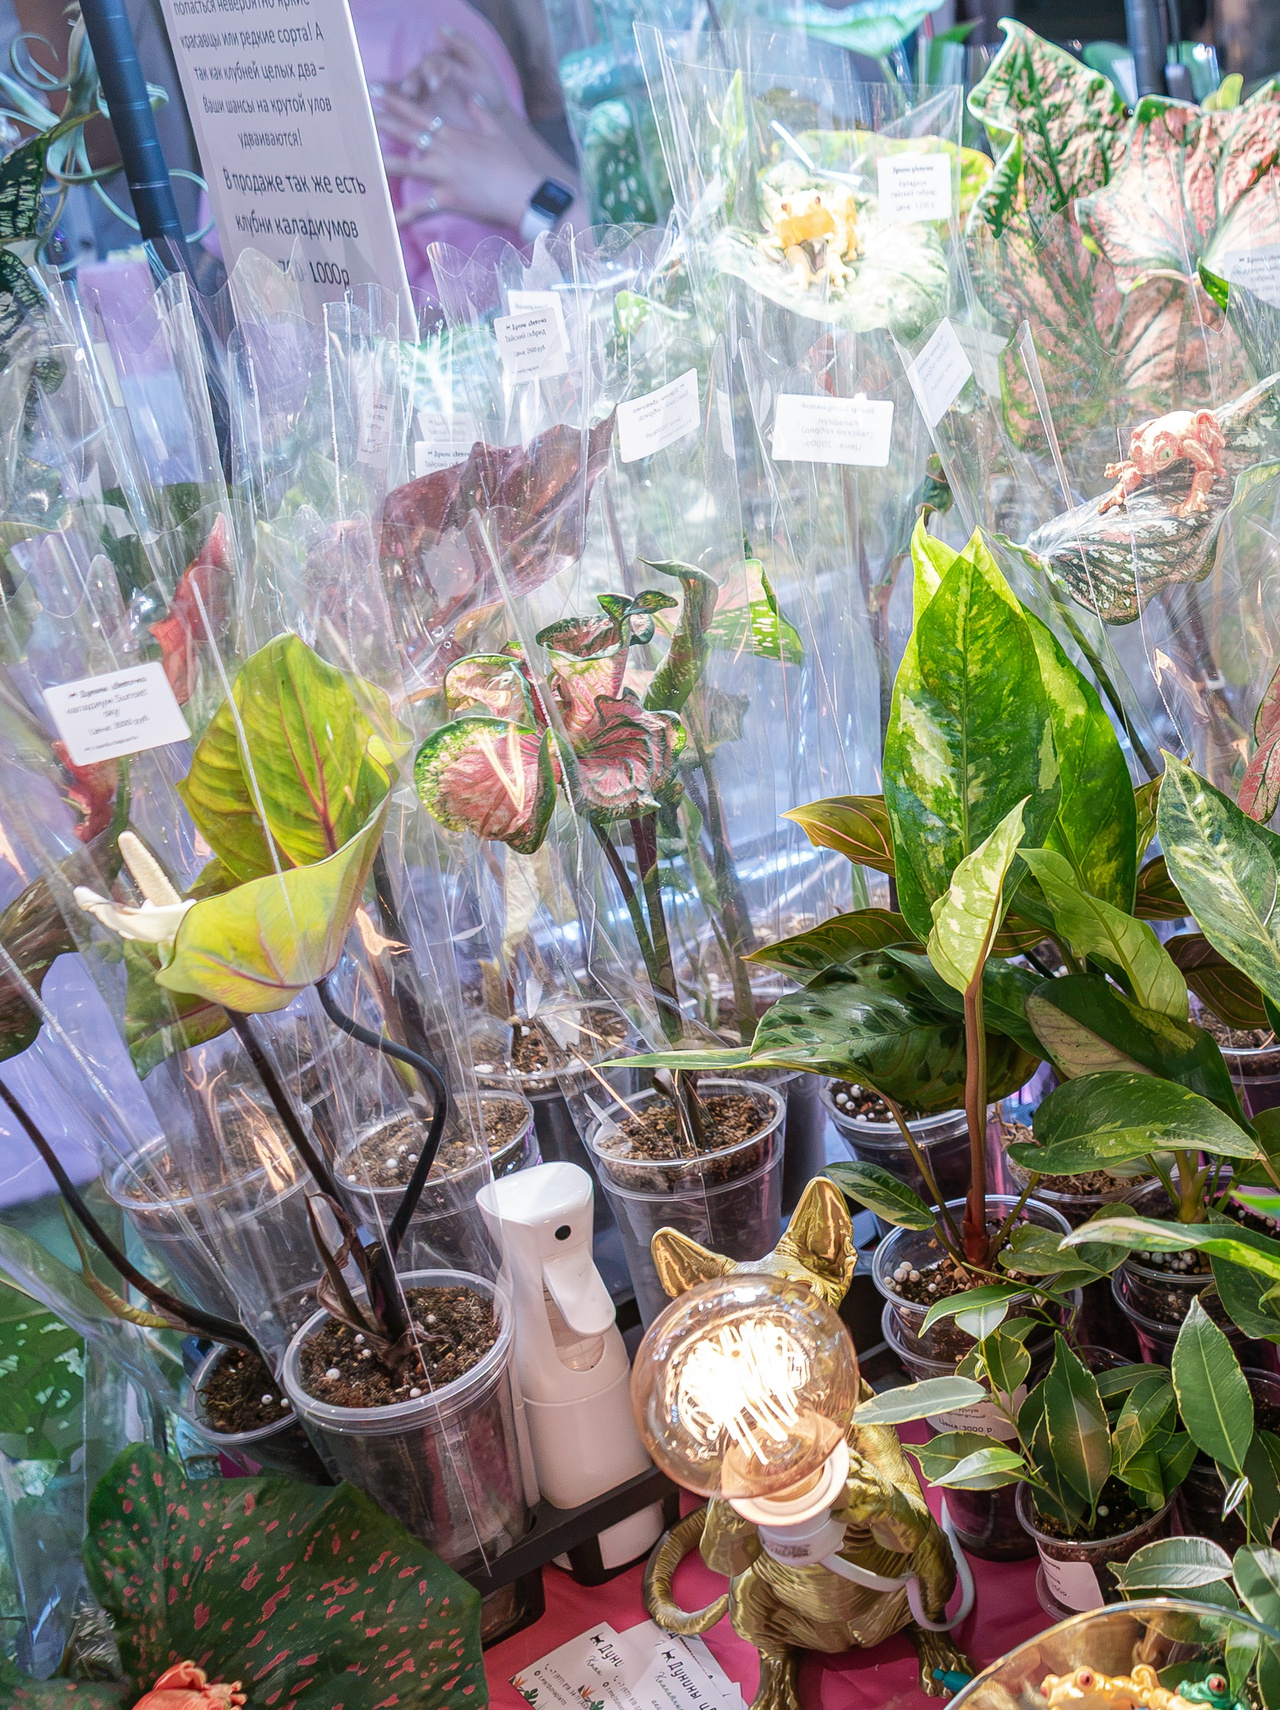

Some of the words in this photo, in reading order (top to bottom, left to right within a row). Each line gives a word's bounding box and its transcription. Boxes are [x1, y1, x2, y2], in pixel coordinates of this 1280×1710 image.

[173, 0, 217, 16] попасться
[180, 32, 220, 52] красавцы
[222, 31, 239, 47] или
[240, 30, 275, 50] редкие
[278, 21, 313, 46] сорта!
[315, 22, 324, 42] А
[194, 67, 209, 81] так
[210, 66, 223, 81] как
[224, 60, 259, 83] клубней
[261, 62, 295, 82] целых
[298, 62, 317, 82] два
[203, 96, 224, 113] Ваши
[226, 99, 254, 114] шансы
[257, 98, 269, 113] на
[272, 93, 306, 117] крутой
[308, 96, 332, 115] улов
[238, 128, 303, 149] удваиваются!
[223, 167, 232, 190] В
[232, 173, 285, 196] продаже
[286, 174, 310, 193] так
[311, 174, 333, 194] же
[335, 174, 366, 195] есть
[235, 209, 273, 237] клубни
[274, 216, 359, 241] каладиумов
[309, 260, 350, 289] 1000р
[962, 1425, 984, 1433] 3000
[668, 1661, 702, 1700] Дунины
